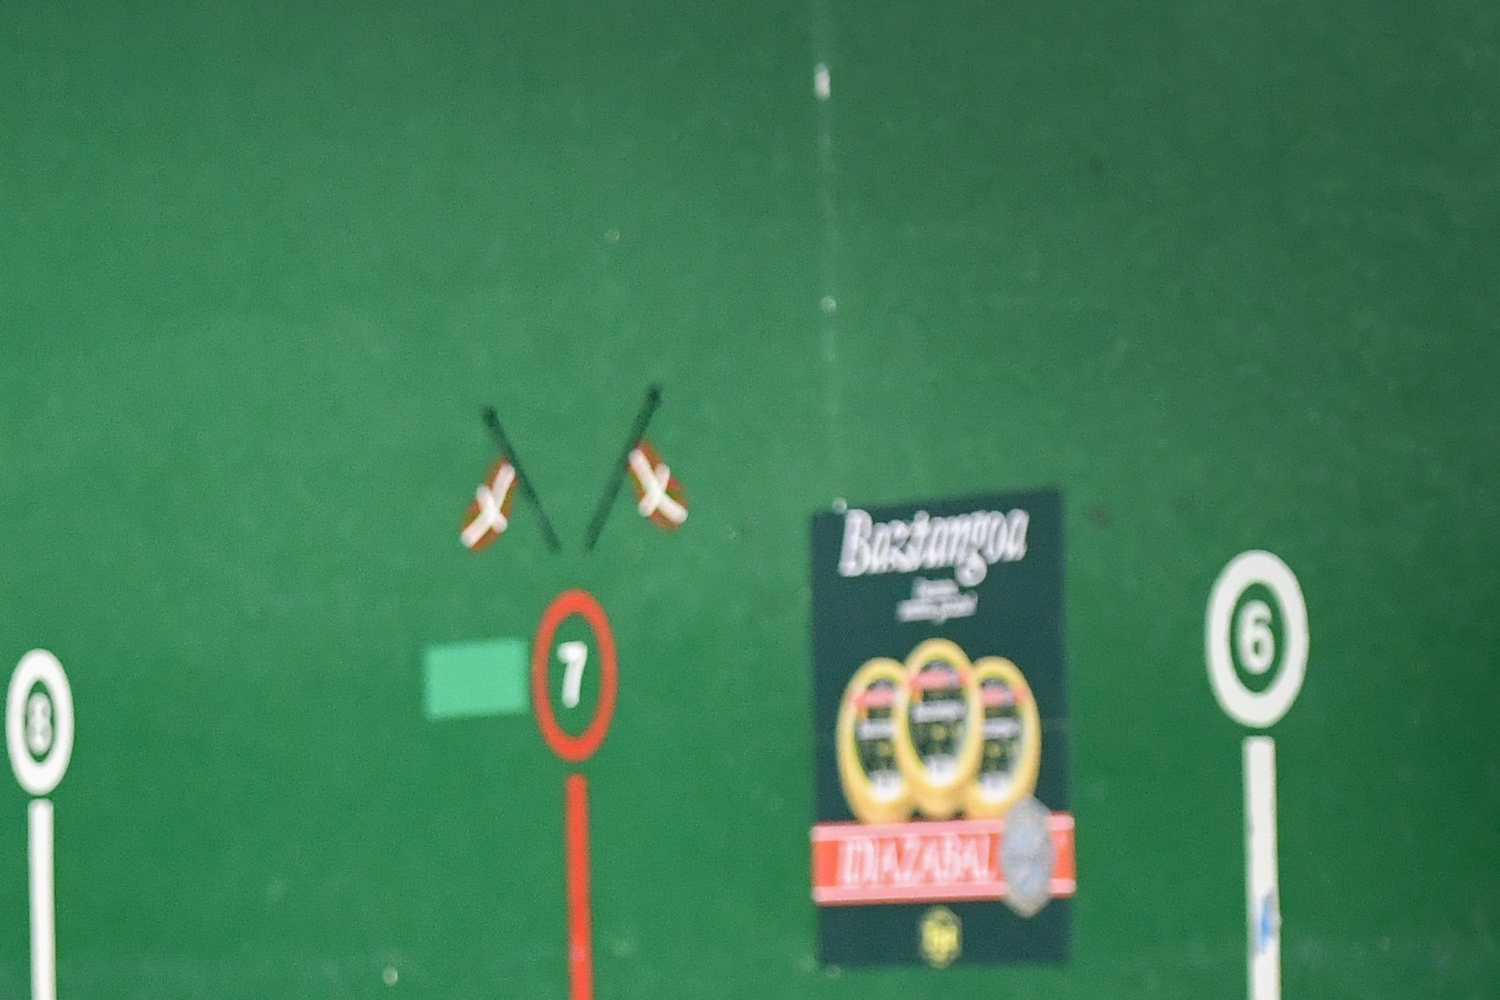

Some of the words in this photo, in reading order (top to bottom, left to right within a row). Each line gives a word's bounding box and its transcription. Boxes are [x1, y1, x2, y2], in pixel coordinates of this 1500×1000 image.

[1238, 599, 1275, 675] 6
[556, 640, 588, 708] 7
[27, 691, 53, 756] 8
